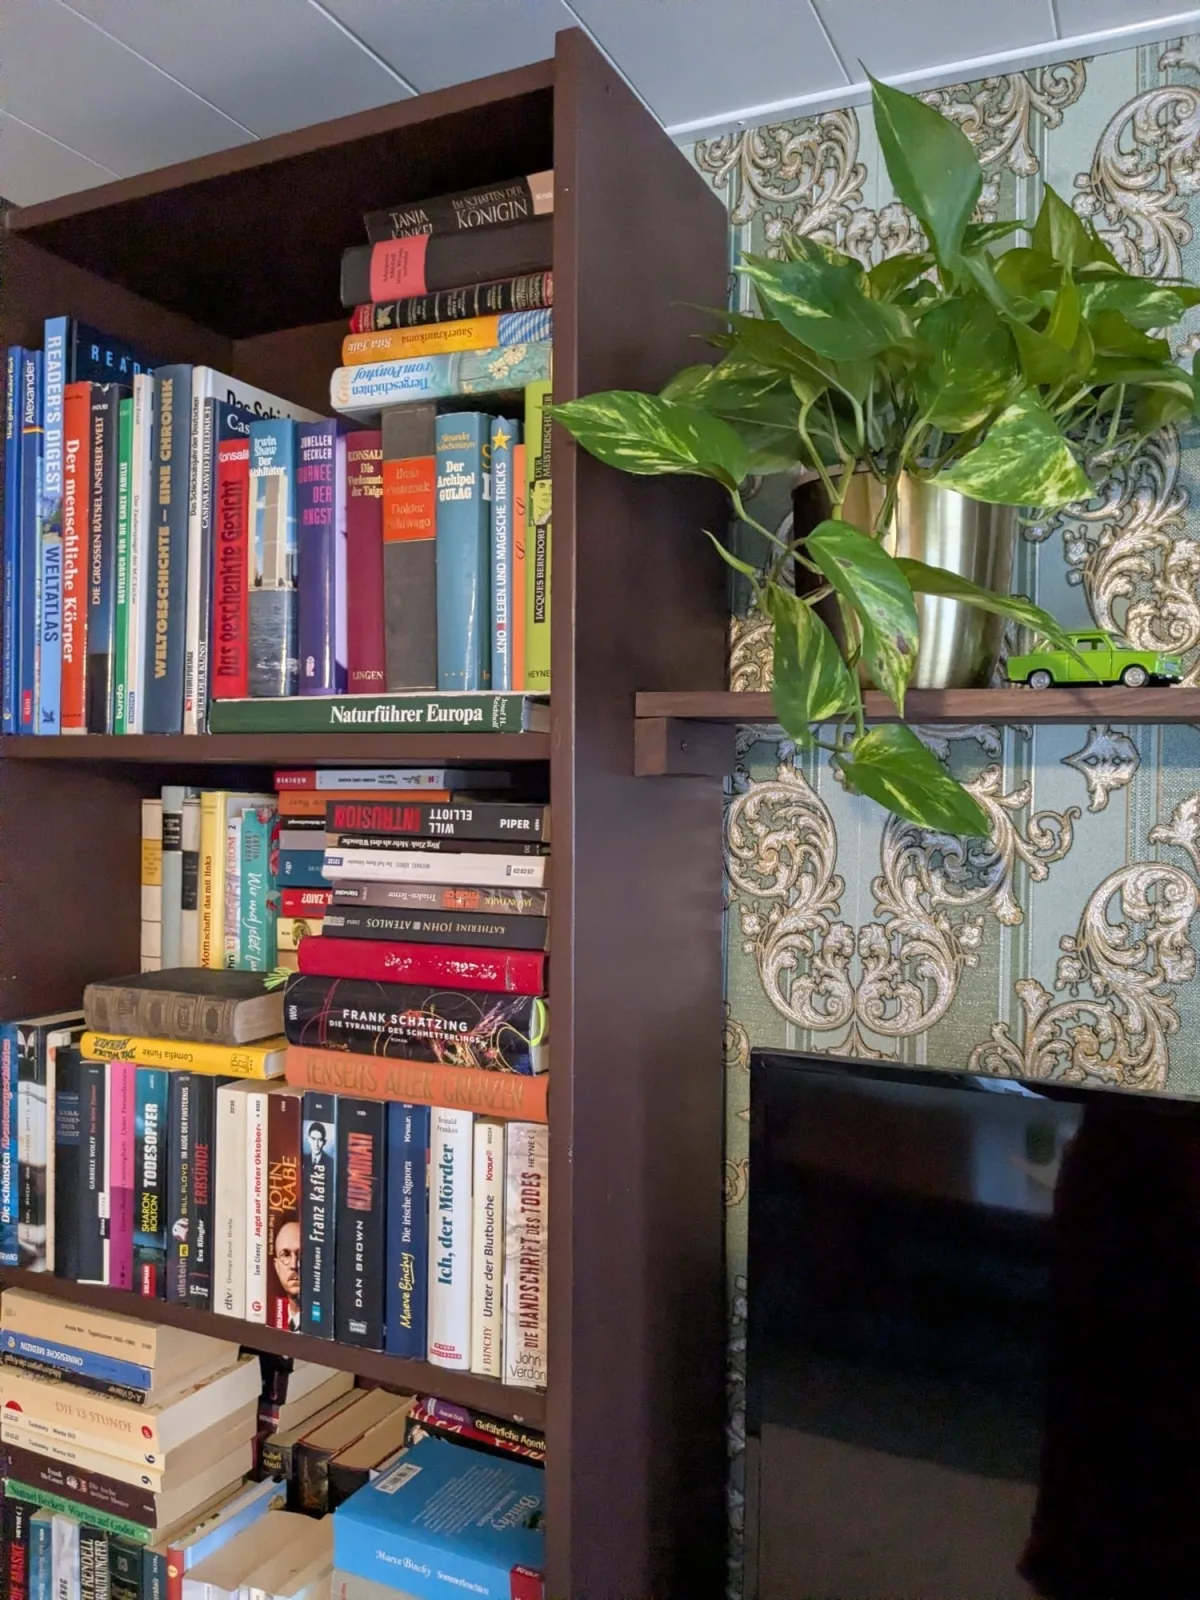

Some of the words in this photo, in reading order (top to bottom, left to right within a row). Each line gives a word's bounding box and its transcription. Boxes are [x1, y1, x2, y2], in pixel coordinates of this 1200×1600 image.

[389, 209, 429, 229] TANJA
[456, 198, 528, 229] KÖNIGIN
[401, 327, 473, 345] Sauerkrautkoma
[46, 335, 62, 423] READER'S
[351, 363, 402, 382] Ponyhof
[351, 376, 429, 396] Tiergeschichten
[25, 359, 36, 424] Alexander
[159, 379, 174, 462] CHRONIK
[191, 396, 200, 435] Deutschen
[95, 416, 104, 444] WELT
[203, 405, 212, 460] FRIEDRICH
[254, 435, 277, 448] Irwin
[46, 430, 61, 494] DIGEST
[66, 438, 80, 473] Der
[254, 446, 277, 457] Shaw
[258, 457, 274, 466] Der
[303, 449, 333, 461] HECKLER
[94, 445, 104, 495] UNSERER
[120, 462, 128, 493] FAMILIE
[202, 461, 210, 491] DAVID
[360, 463, 374, 474] Die
[436, 472, 475, 488] Archipel
[445, 461, 465, 473] Der
[535, 458, 543, 478] DER
[159, 465, 171, 505] EINE
[312, 486, 333, 503] DER
[439, 487, 472, 502] GULAG
[495, 462, 507, 502] TRICKS
[92, 496, 103, 532] RÄTSEL
[119, 494, 127, 520] GANZE
[201, 492, 209, 528] CASPAR
[220, 480, 243, 543] Gesicht
[303, 508, 333, 526] ANGST
[64, 478, 79, 591] menschliche
[118, 523, 126, 536] DIE
[495, 505, 506, 560] MAGISCHE
[92, 534, 101, 586] GROSSEN
[117, 539, 126, 553] FÜR
[536, 528, 546, 579] BERNDORF
[117, 557, 126, 605] BASTELBUCH
[496, 563, 506, 586] UND
[44, 546, 60, 642] WELTATLAS
[92, 589, 100, 605] DIE
[155, 526, 170, 680] WELTGESCHICHTE
[218, 546, 242, 641] geschenkte
[535, 579, 544, 621] JACQUES
[63, 597, 77, 664] Körper
[198, 641, 206, 677] KUNST
[217, 647, 239, 677] Das
[197, 678, 205, 696] DER
[352, 670, 384, 681] LINGEN
[527, 670, 551, 679] HEYNE
[116, 683, 124, 719] burda
[197, 697, 205, 719] WELT
[330, 703, 423, 726] Naturführer
[426, 703, 484, 726] Europa
[333, 804, 421, 832] INTRUSION
[428, 808, 473, 821] ELLIOTT
[430, 823, 454, 834] WILL
[499, 818, 530, 830] PIPER
[342, 837, 370, 847] Wünsche
[370, 838, 383, 847] drei
[383, 839, 392, 847] als
[392, 839, 409, 848] Mehr
[204, 855, 212, 877] links
[247, 872, 262, 897] Wir
[301, 893, 324, 904] ZAID?
[388, 891, 437, 902] Triaden-Terror
[203, 894, 211, 910] das
[246, 898, 262, 922] und
[202, 911, 211, 941] schafft
[242, 917, 261, 955] jetzt
[366, 919, 412, 931] ATEMLOS
[423, 921, 453, 933] JOHN
[456, 923, 506, 934] KATHERINE
[201, 941, 211, 969] Mom
[329, 1019, 343, 1028] DIE
[345, 1021, 385, 1034] TYRANNEI
[388, 1026, 404, 1036] DES
[406, 1028, 481, 1044] SCHMETTERLINGS
[342, 1008, 386, 1024] FRANK
[390, 1013, 468, 1032] SCHÄTZING
[142, 1048, 163, 1059] Funke
[164, 1050, 194, 1063] Cornelia
[305, 1054, 378, 1093] JENSEITS
[384, 1064, 435, 1100] ALLER
[441, 1071, 524, 1111] GRENZEN
[181, 1087, 189, 1121] FINSTERNIS
[143, 1103, 159, 1188] TODESOPFER
[181, 1151, 188, 1159] IM
[527, 1141, 535, 1168] HEYNE
[1, 1152, 11, 1205] schönsten
[180, 1163, 188, 1196] FLOYD
[192, 1142, 209, 1205] ERBSÜNDE
[282, 1155, 298, 1211] RABE
[310, 1163, 327, 1202] Kafka
[347, 1131, 374, 1212] ILLUMINATI
[402, 1160, 414, 1195] Signora
[438, 1143, 455, 1213] Mörder
[268, 1160, 284, 1213] JOHN
[520, 1171, 541, 1215] TODES
[1, 1205, 11, 1224] Die
[142, 1192, 150, 1233] SHARON
[149, 1194, 158, 1233] BOLTON
[180, 1196, 188, 1215] BILL
[254, 1199, 262, 1214] auf
[401, 1196, 413, 1225] irische
[196, 1219, 206, 1249] Klingler
[254, 1215, 263, 1238] Jagd
[309, 1206, 326, 1243] Franz
[401, 1226, 413, 1243] Die
[437, 1216, 454, 1249] der
[483, 1194, 495, 1257] Blutbuche
[525, 1216, 541, 1236] DES
[196, 1249, 205, 1262] Eva
[253, 1243, 263, 1263] Clancy
[355, 1219, 364, 1272] BROWN
[177, 1257, 188, 1297] ullstein
[253, 1264, 261, 1276] Tom
[312, 1265, 321, 1293] Ronald
[398, 1252, 415, 1291] Binchy
[437, 1252, 456, 1286] Ich,
[483, 1258, 494, 1281] der
[519, 1236, 540, 1330] HANDSCHRIFT
[224, 1291, 234, 1311] dtv
[355, 1278, 363, 1308] DAN
[483, 1282, 495, 1318] Unter
[276, 1298, 284, 1329] GOLDMANN
[401, 1291, 413, 1329] Maeve
[20, 1341, 46, 1356] MEDIZIN
[482, 1326, 492, 1365] BINCHY
[523, 1331, 539, 1349] DIE
[46, 1348, 84, 1366] CHINESISCHE
[514, 1351, 542, 1367] John
[509, 1363, 547, 1381] Verdon
[55, 1401, 73, 1415] DIE
[88, 1412, 133, 1432] STUNDE
[475, 1418, 520, 1442] Gefährliche
[491, 1494, 540, 1531] Binchy
[15, 1515, 23, 1539] HEYNE
[11, 1542, 25, 1583] MASKE
[80, 1538, 95, 1588] RENDELL
[375, 1549, 404, 1567] Maeve
[402, 1556, 433, 1580] Binchy
